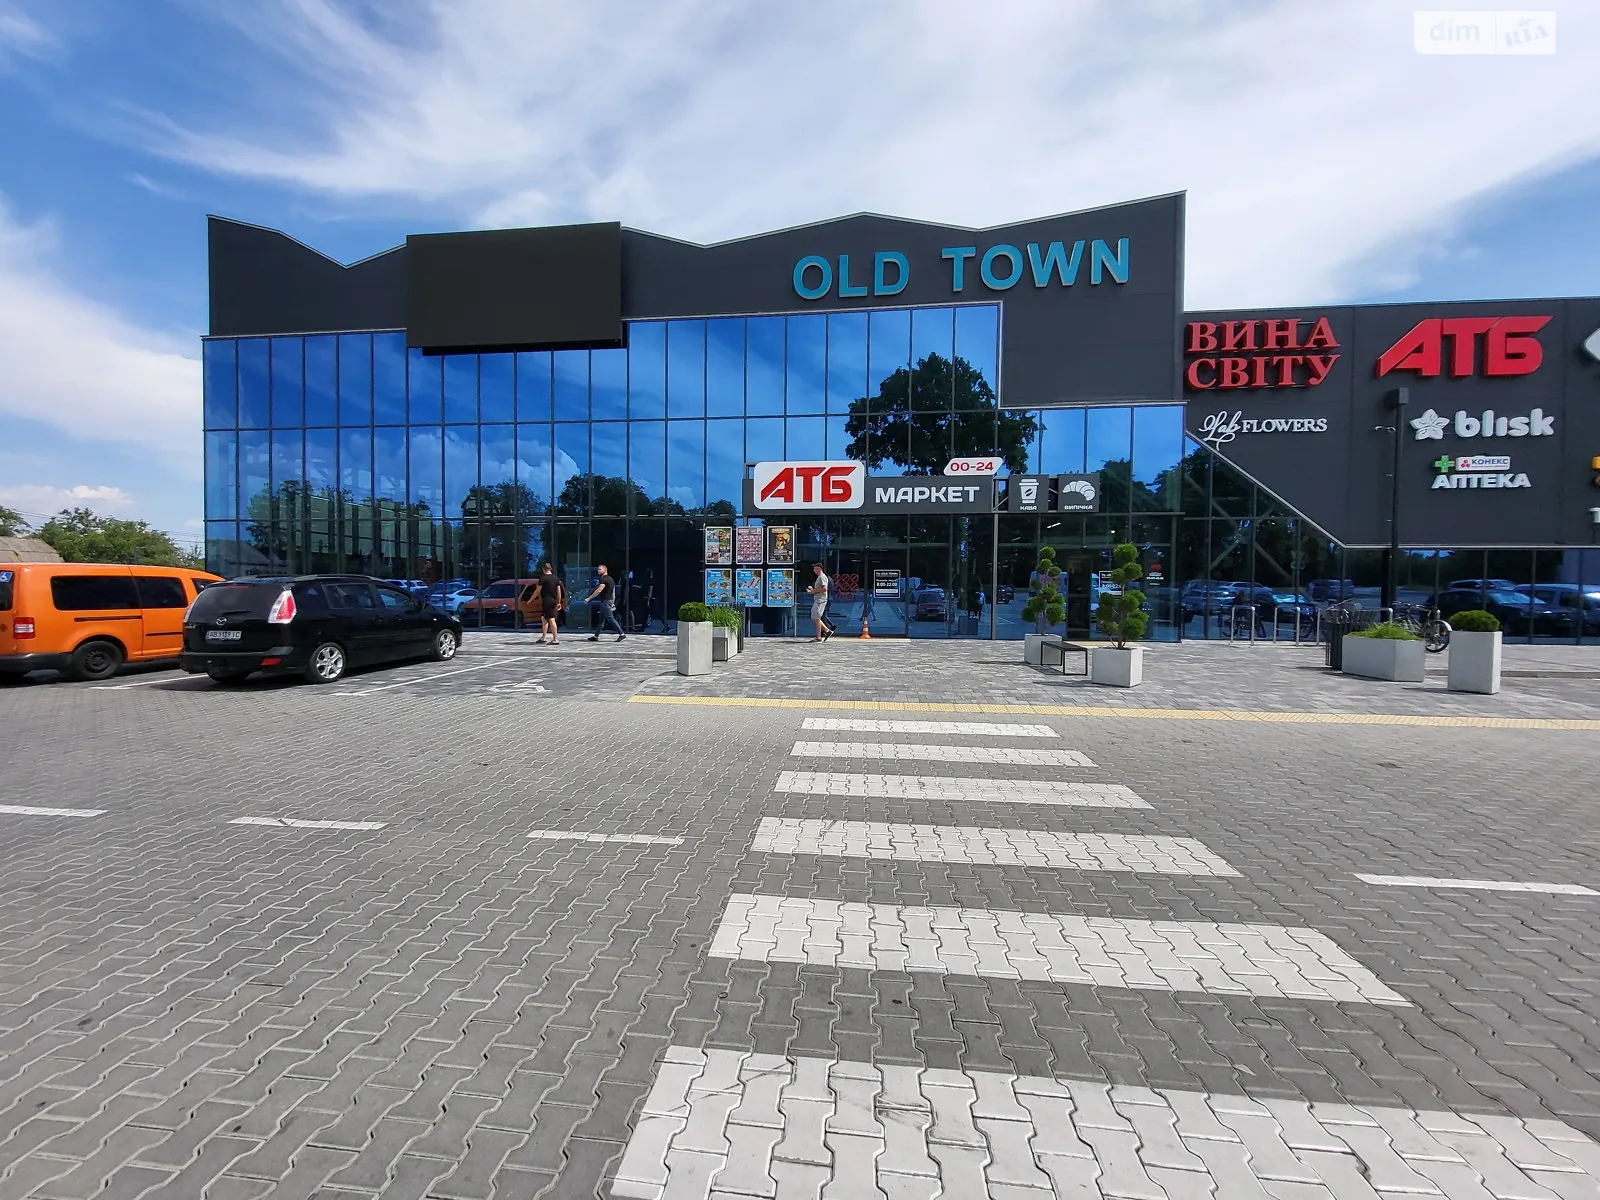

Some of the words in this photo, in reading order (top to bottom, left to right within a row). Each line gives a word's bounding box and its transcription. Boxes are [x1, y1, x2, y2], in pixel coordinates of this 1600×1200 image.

[793, 251, 910, 300] OLD
[941, 237, 1130, 292] TOWN
[1185, 315, 1341, 352] ВИНА
[1375, 315, 1553, 378] АТБ
[1185, 354, 1341, 389] СВІТУ
[1241, 418, 1328, 433] FLOWERS
[950, 461, 994, 472] 00-24
[1431, 473, 1532, 489] АПТЕКА
[760, 466, 857, 503] АТБ
[875, 486, 980, 504] МАРКЕТ
